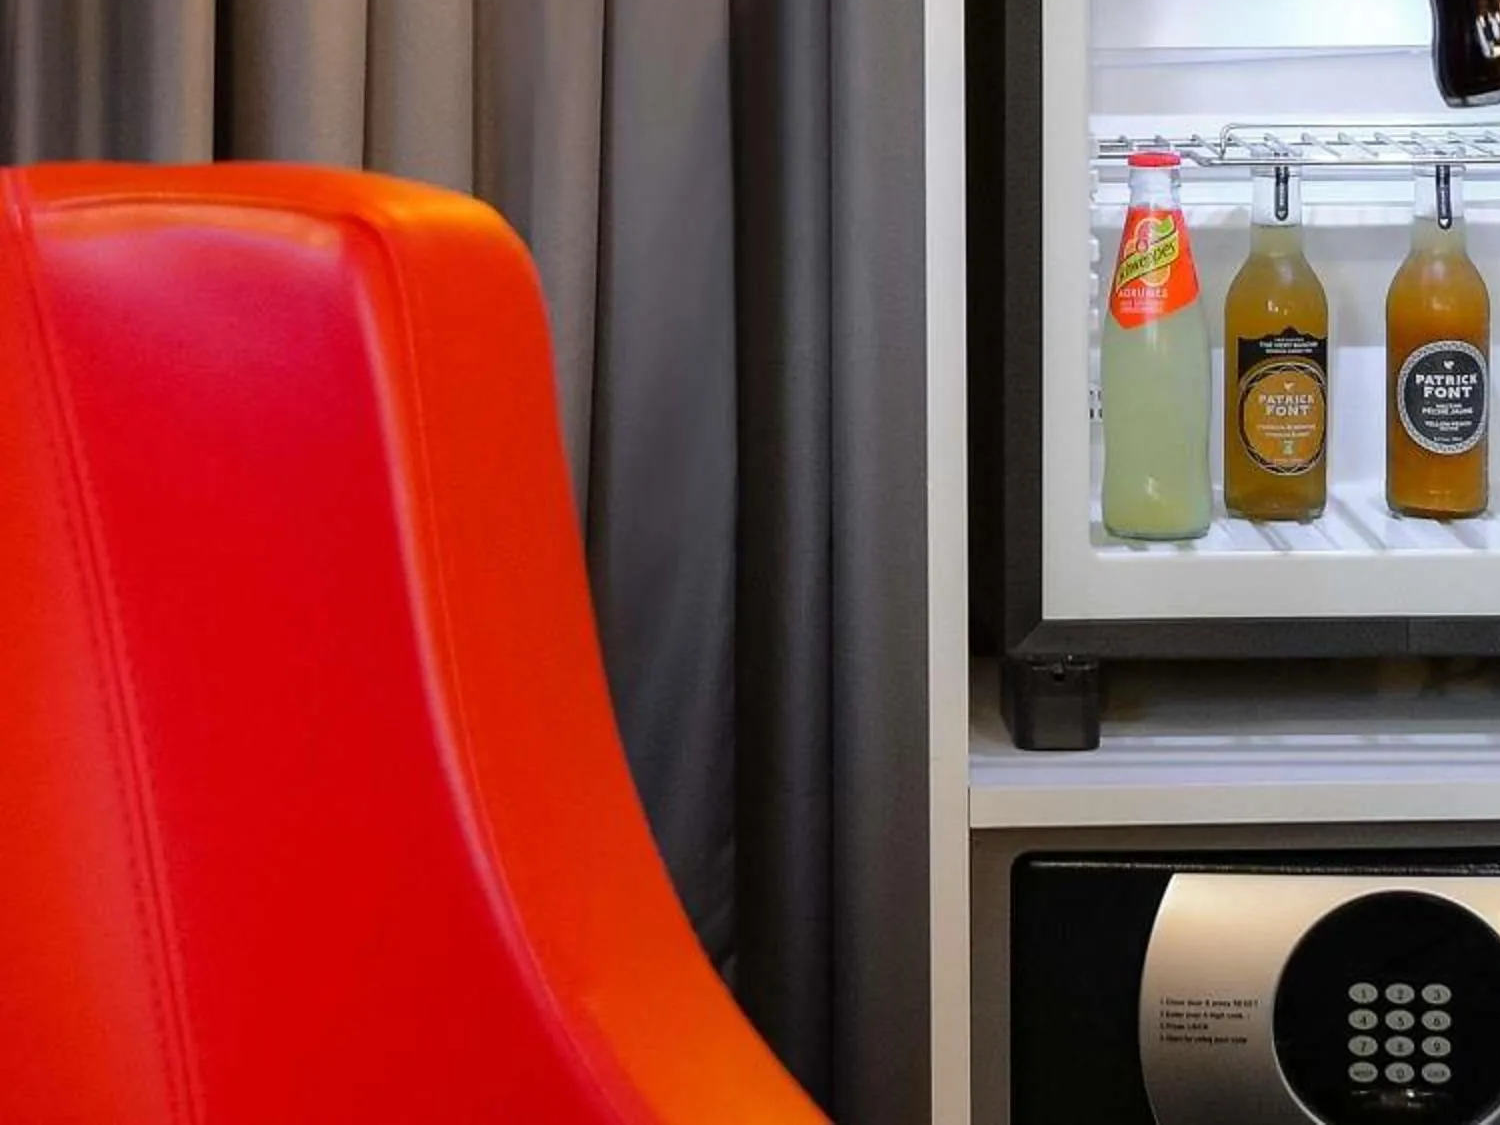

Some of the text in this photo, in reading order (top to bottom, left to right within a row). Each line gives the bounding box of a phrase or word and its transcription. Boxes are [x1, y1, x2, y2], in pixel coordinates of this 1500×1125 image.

[1415, 373, 1478, 386] PATRICK
[1423, 386, 1473, 398] FONT
[1258, 394, 1315, 405] PATRICK
[1265, 405, 1310, 416] FONT
